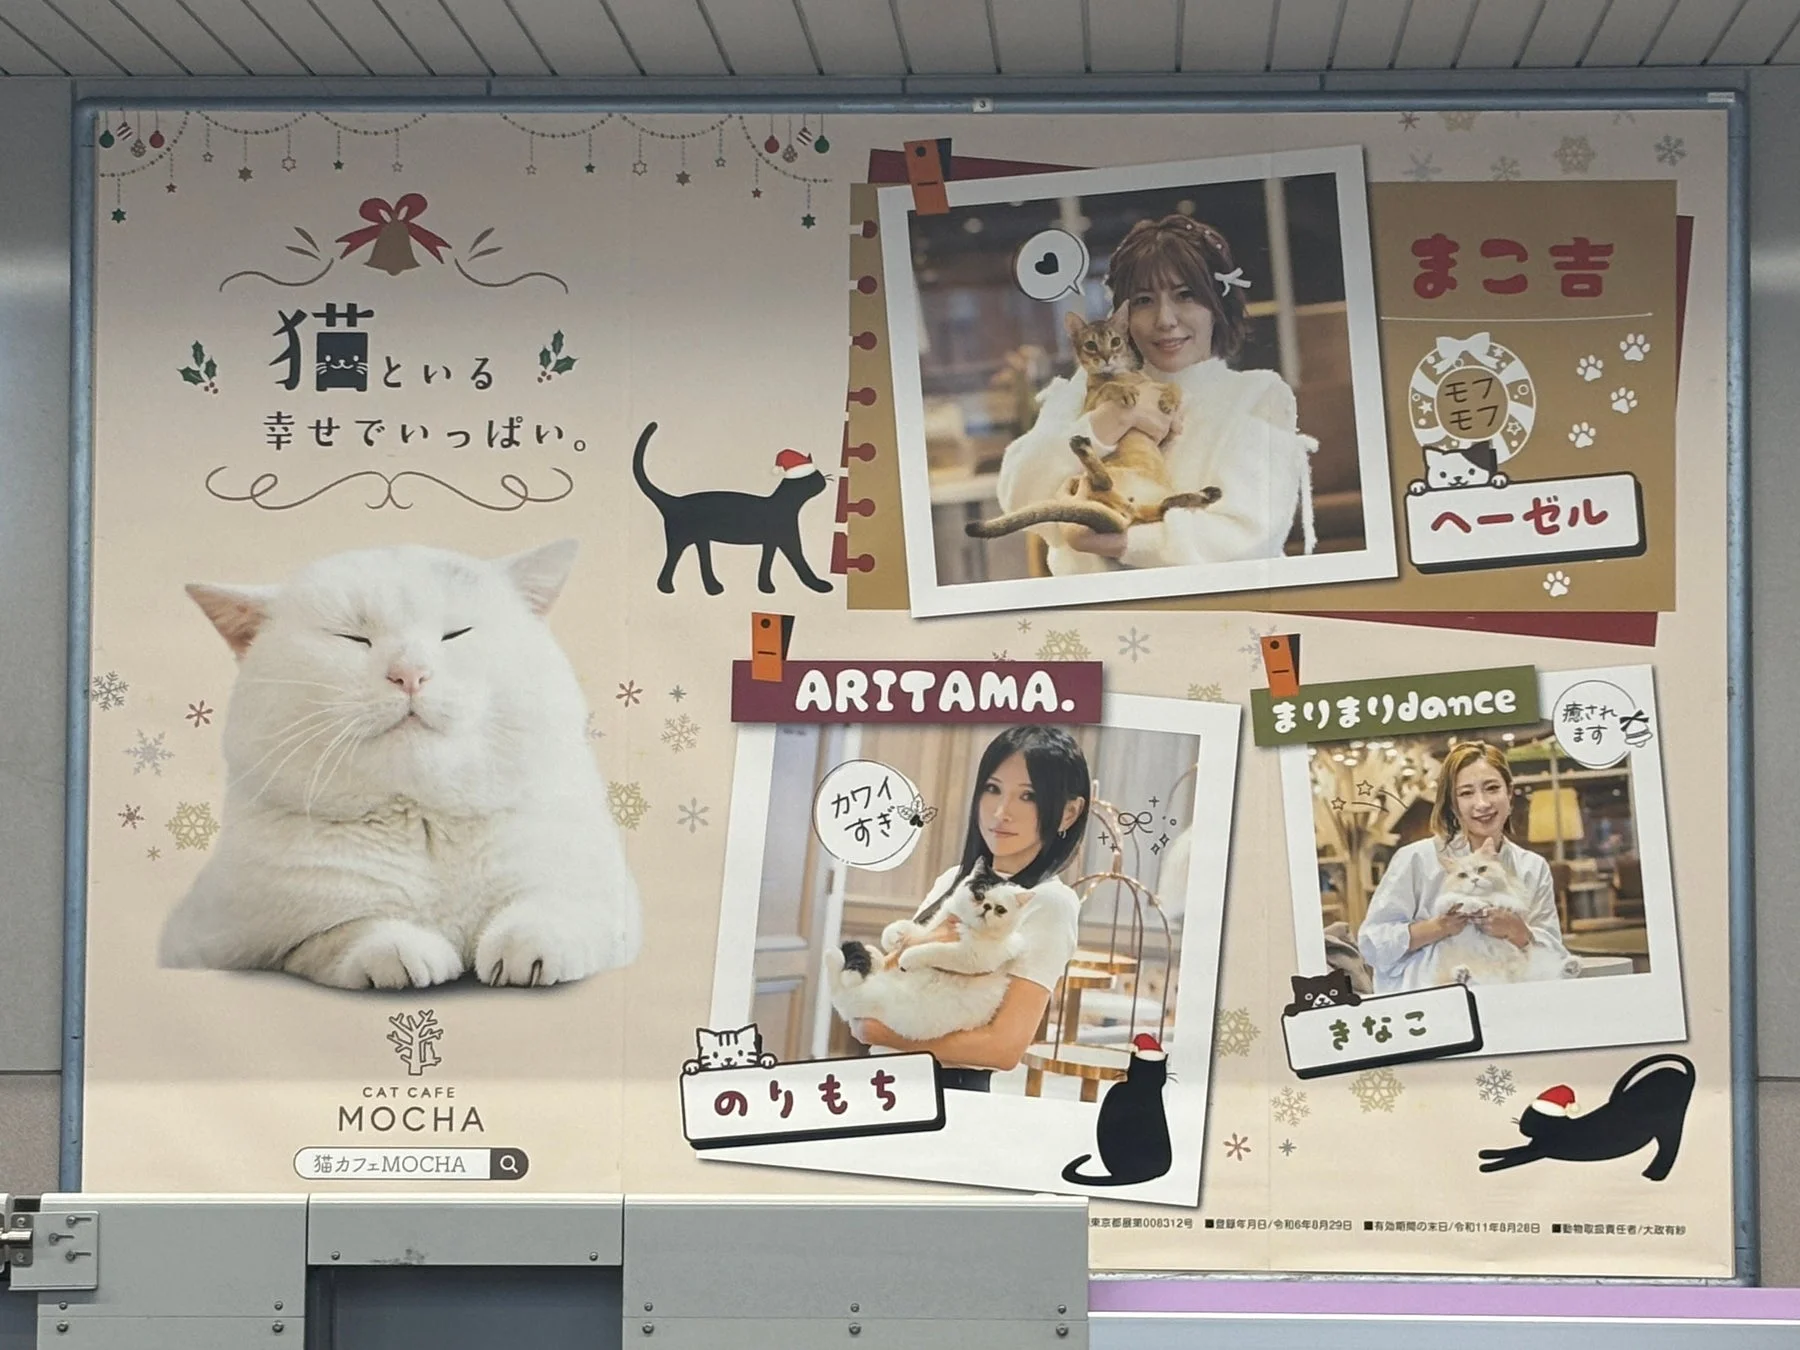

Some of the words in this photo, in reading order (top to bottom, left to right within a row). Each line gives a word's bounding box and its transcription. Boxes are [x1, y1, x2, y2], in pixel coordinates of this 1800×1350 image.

[1411, 233, 1614, 298] まこ吉
[268, 302, 494, 392] 猫といる
[1444, 377, 1494, 403] モフ
[263, 410, 586, 452] 幸せでいっぱい。
[1449, 405, 1499, 431] モフ
[1430, 495, 1609, 535] ヘーゼル
[794, 668, 1076, 713] ARITAMA.
[1271, 688, 1518, 734] まりまりdance
[1562, 701, 1618, 723] 癒され
[1572, 724, 1608, 746] ます
[830, 775, 892, 820] カワイ
[844, 804, 896, 848] すぎ
[1328, 1010, 1427, 1051] きなこ
[362, 1086, 399, 1098] CAT
[407, 1086, 456, 1098] CAFE
[714, 1069, 896, 1118] のりもち
[338, 1106, 485, 1132] MOCHA
[313, 1154, 466, 1174] 猫カフェMOCHA
